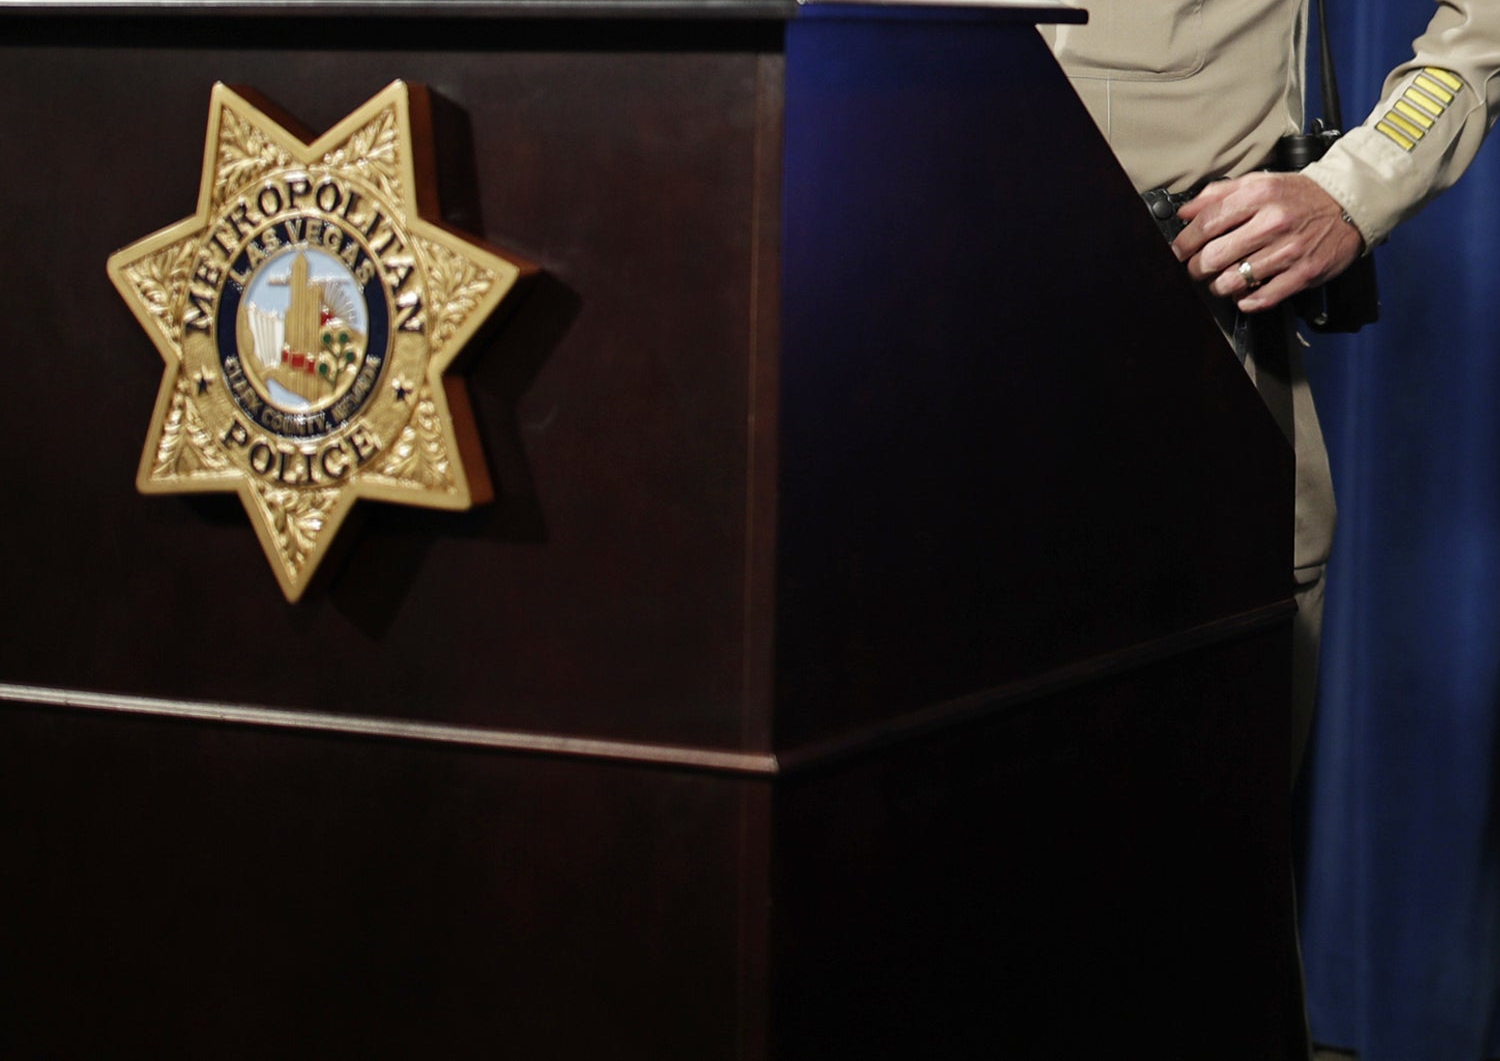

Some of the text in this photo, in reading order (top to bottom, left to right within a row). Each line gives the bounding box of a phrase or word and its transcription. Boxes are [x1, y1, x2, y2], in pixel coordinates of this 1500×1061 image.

[184, 177, 425, 335] METROPOLITAN
[229, 217, 376, 289] LAS VEGAS
[221, 421, 383, 485] POLICE
